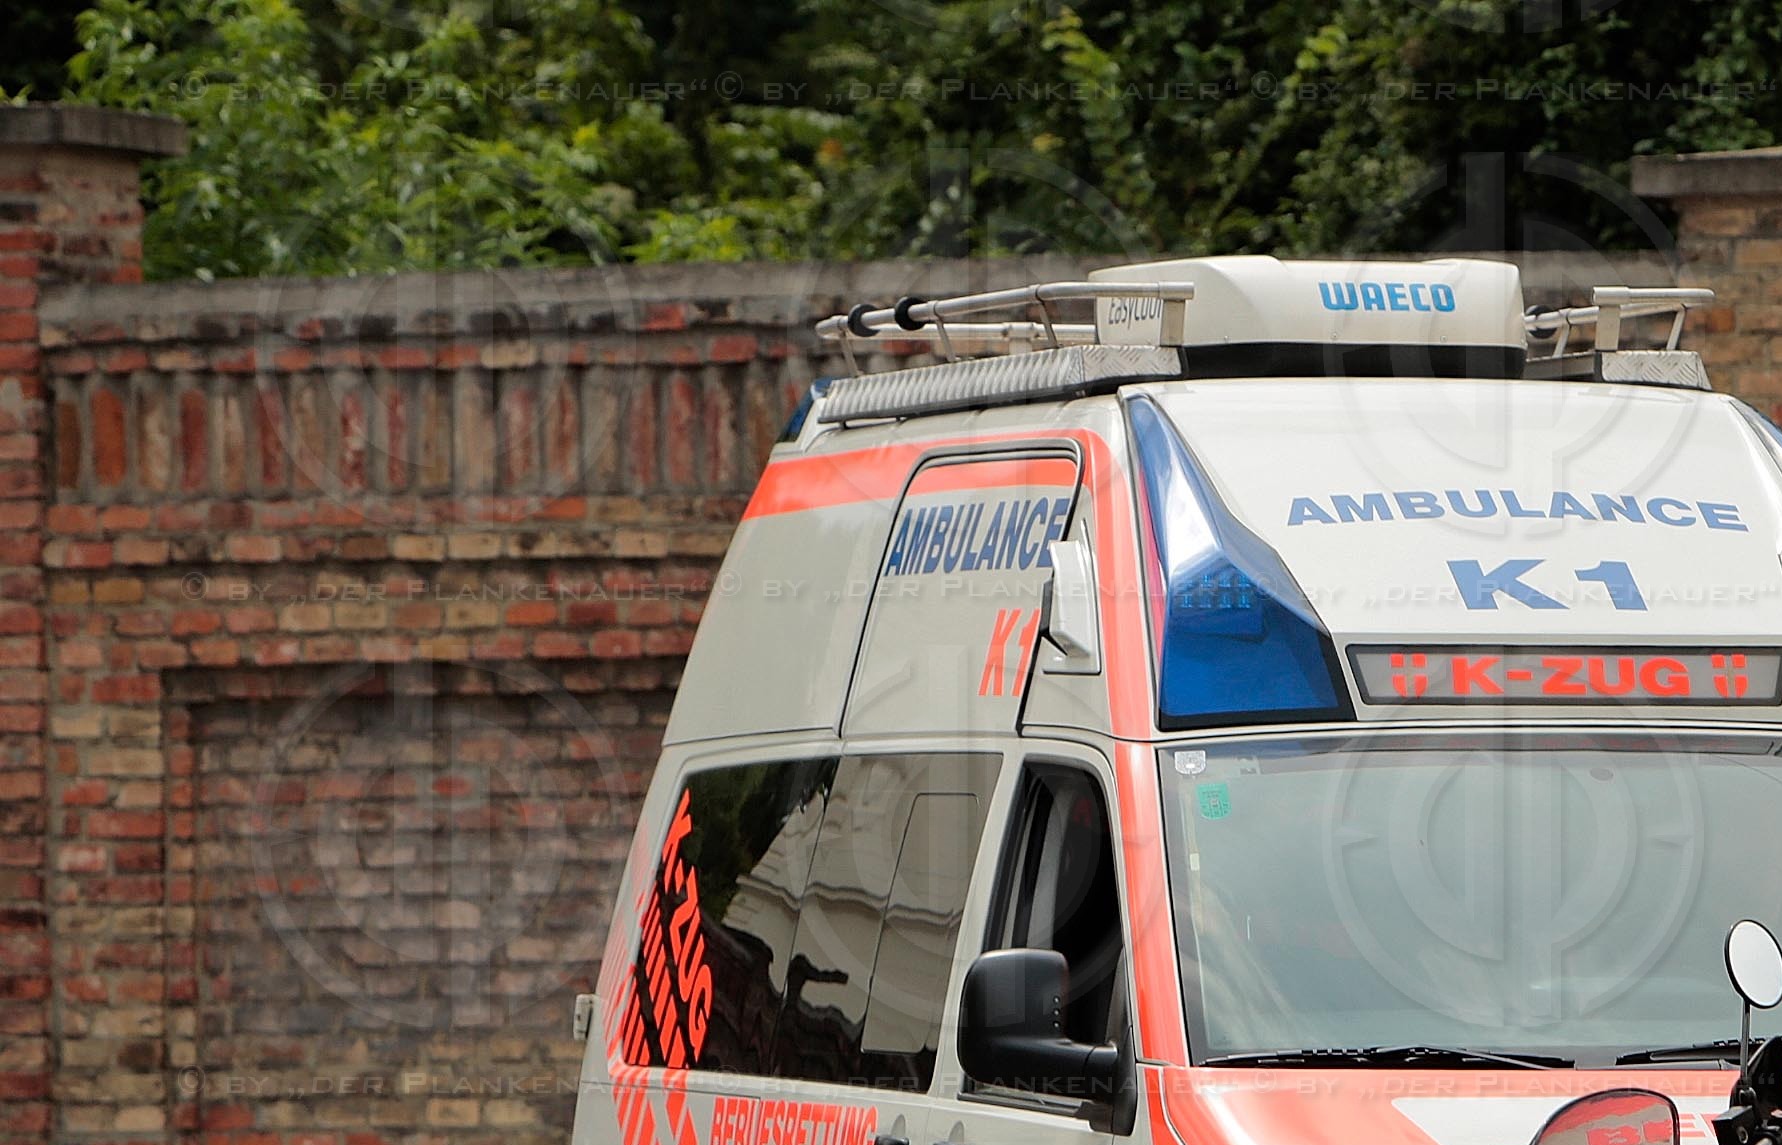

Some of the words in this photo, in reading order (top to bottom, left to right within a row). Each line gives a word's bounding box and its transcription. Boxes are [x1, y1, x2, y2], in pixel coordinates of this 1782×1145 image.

[1318, 282, 1455, 312] WAECO
[1287, 489, 1749, 532] AMBULANCE
[883, 497, 1072, 577] AMBULANCE
[1446, 559, 1649, 611] K1
[977, 608, 1041, 697] K1
[1450, 654, 1692, 697] K-ZUG
